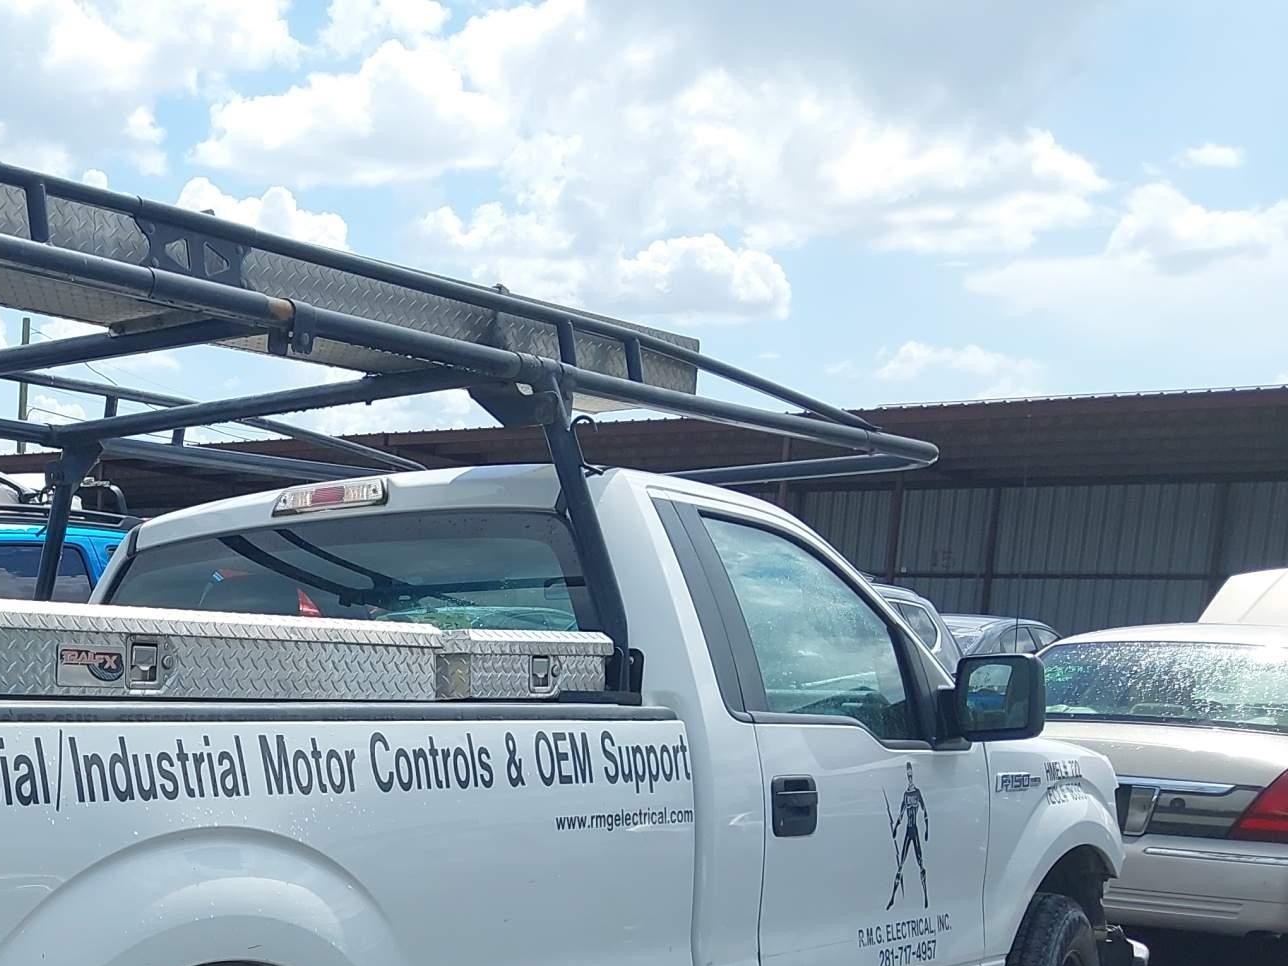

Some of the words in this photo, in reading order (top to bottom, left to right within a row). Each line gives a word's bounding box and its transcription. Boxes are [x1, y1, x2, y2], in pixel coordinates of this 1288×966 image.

[258, 734, 357, 798] Motor
[369, 731, 494, 793] Controls
[505, 731, 526, 788] &
[535, 730, 594, 786] OEM
[600, 730, 691, 794] Support
[555, 807, 694, 832] www.rmgelectrical.com
[858, 926, 885, 948] R.M.G.
[886, 917, 937, 943] ELECTRICAL,
[937, 913, 952, 932] INC.
